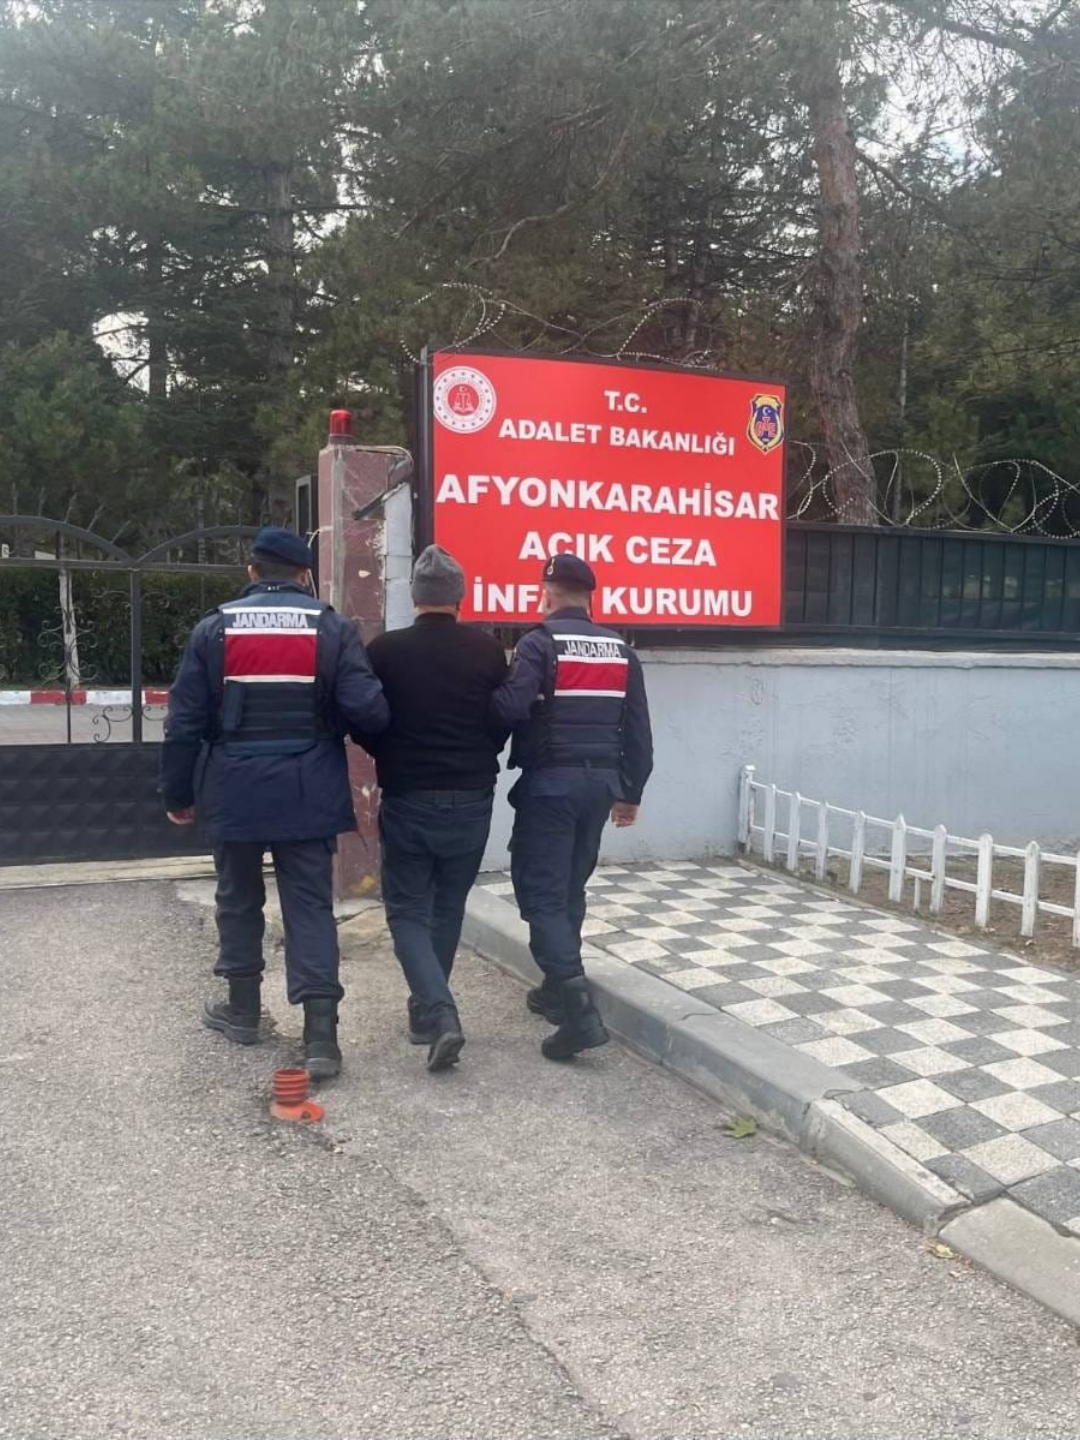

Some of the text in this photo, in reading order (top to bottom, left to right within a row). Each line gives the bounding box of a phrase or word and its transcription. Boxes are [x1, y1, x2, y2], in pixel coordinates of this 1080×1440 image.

[604, 390, 647, 413] T.C.
[498, 418, 735, 456] ADALET BAKANLIĞI
[435, 474, 779, 521] AFYONKARAHİSAR
[625, 535, 717, 567] CEZA
[473, 576, 752, 617] İNF KURUMU
[232, 613, 309, 628] JANDARMA
[564, 640, 622, 658] JANDARMA
